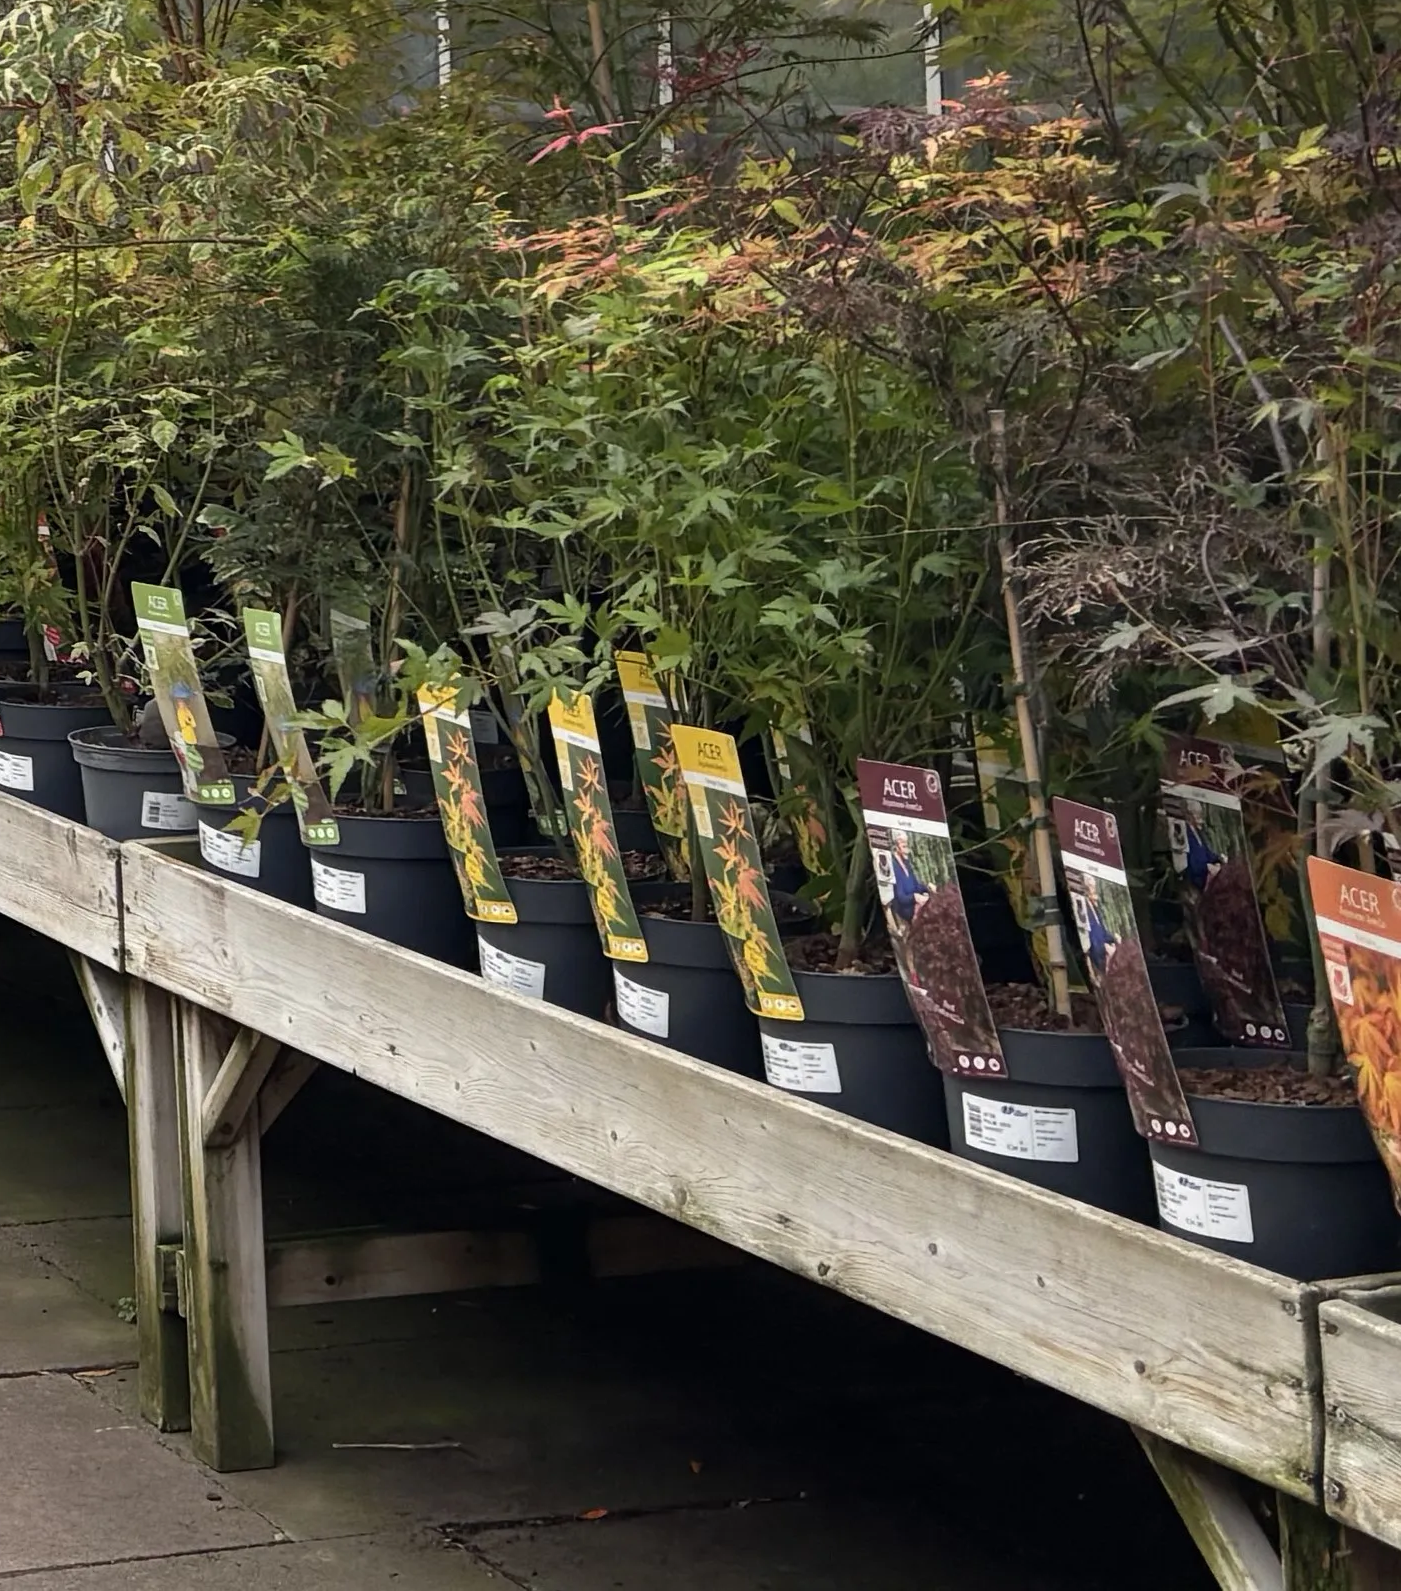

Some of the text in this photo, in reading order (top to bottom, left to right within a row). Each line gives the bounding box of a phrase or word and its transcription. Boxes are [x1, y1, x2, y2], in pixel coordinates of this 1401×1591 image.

[698, 741, 724, 761] ACER
[883, 777, 918, 800] ACER
[1074, 818, 1101, 844] ACER
[1340, 883, 1381, 916] ACER
